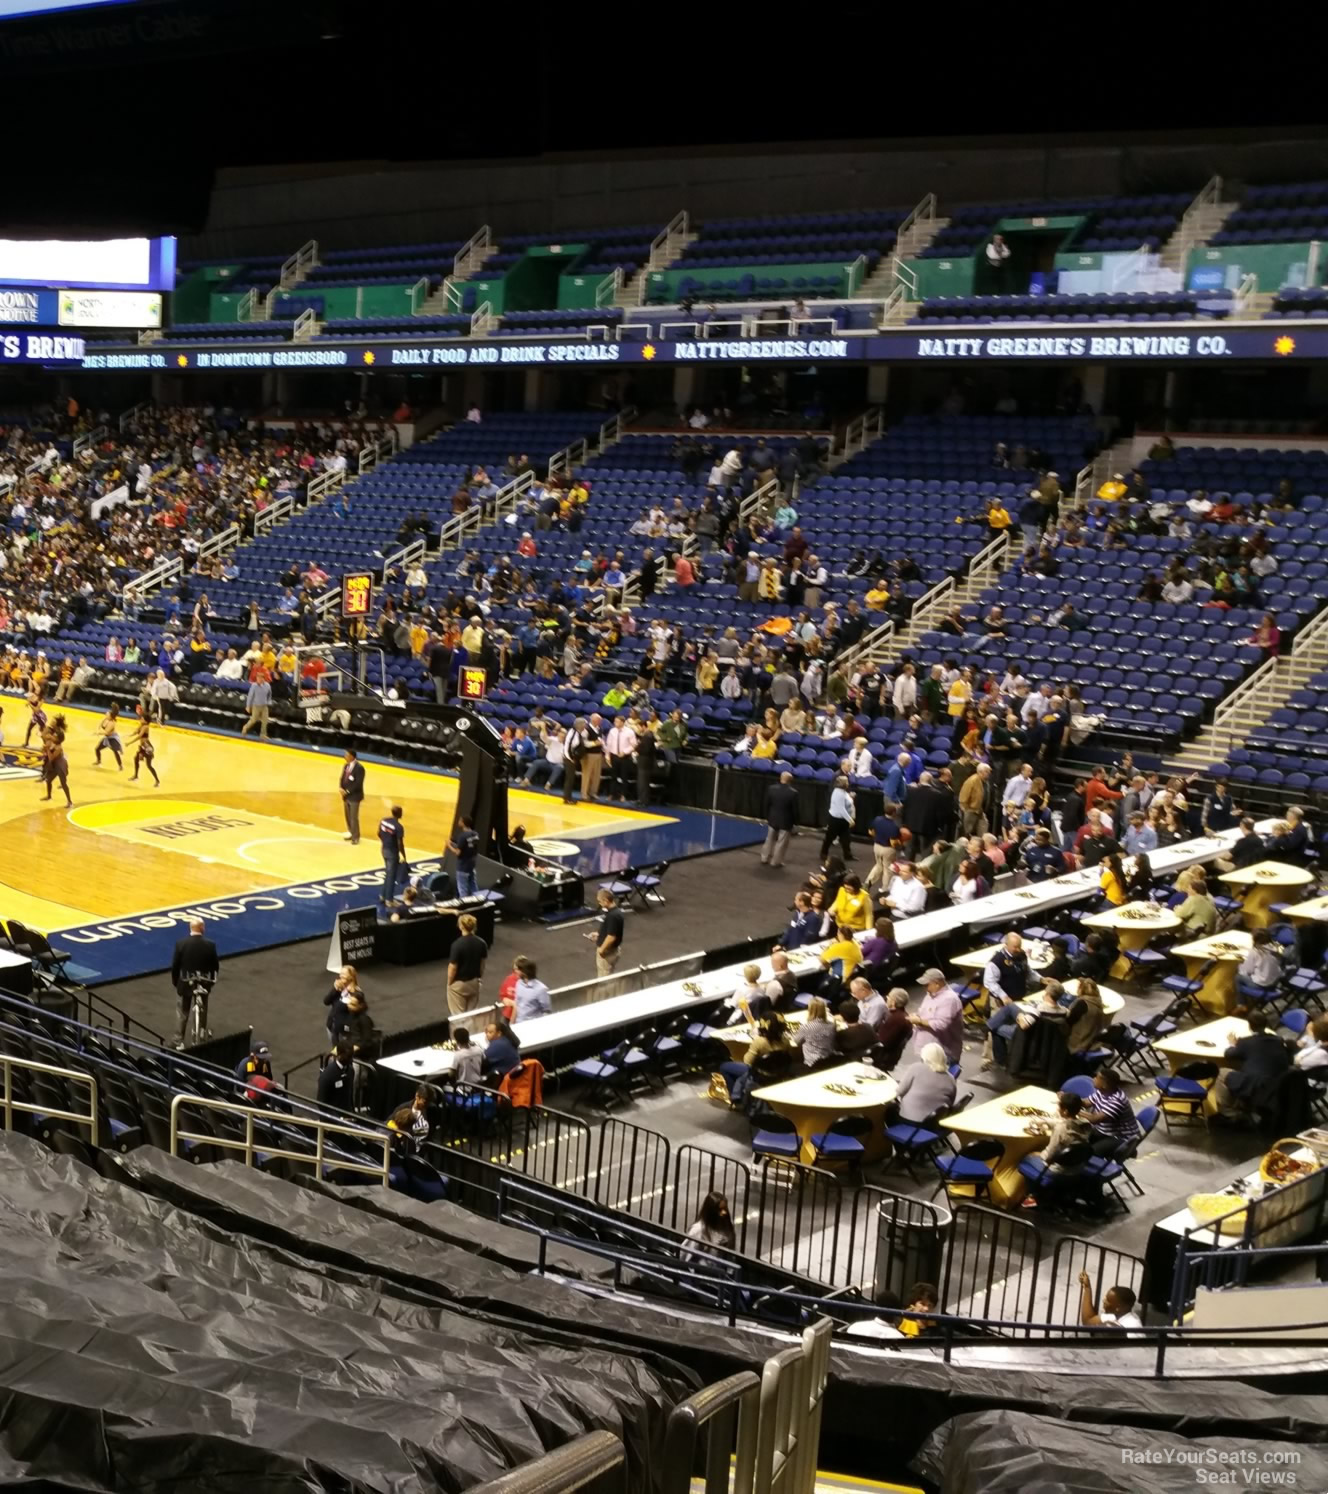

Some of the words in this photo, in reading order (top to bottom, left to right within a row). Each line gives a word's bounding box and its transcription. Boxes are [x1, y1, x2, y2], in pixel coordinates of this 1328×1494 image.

[391, 349, 430, 364] DAILY
[432, 348, 468, 363] FOOD
[469, 347, 499, 363] AND
[499, 346, 546, 362] DRINK
[547, 344, 619, 361] SPECIALS
[674, 340, 848, 358] NATTYGREENES.COM
[918, 338, 984, 356] NATTY
[986, 337, 1087, 356] GREENE'S
[1089, 336, 1191, 356] BREWING
[1196, 335, 1233, 355] CO.
[106, 355, 150, 368] BREWING
[197, 353, 210, 367] IN
[211, 352, 272, 367] DOWNTOWN
[272, 350, 347, 366] GREENSBORO
[348, 590, 368, 612] 30
[343, 939, 355, 951] BEST
[355, 936, 369, 948] SEATS
[347, 951, 357, 961] THE
[357, 947, 373, 959] HOUSE
